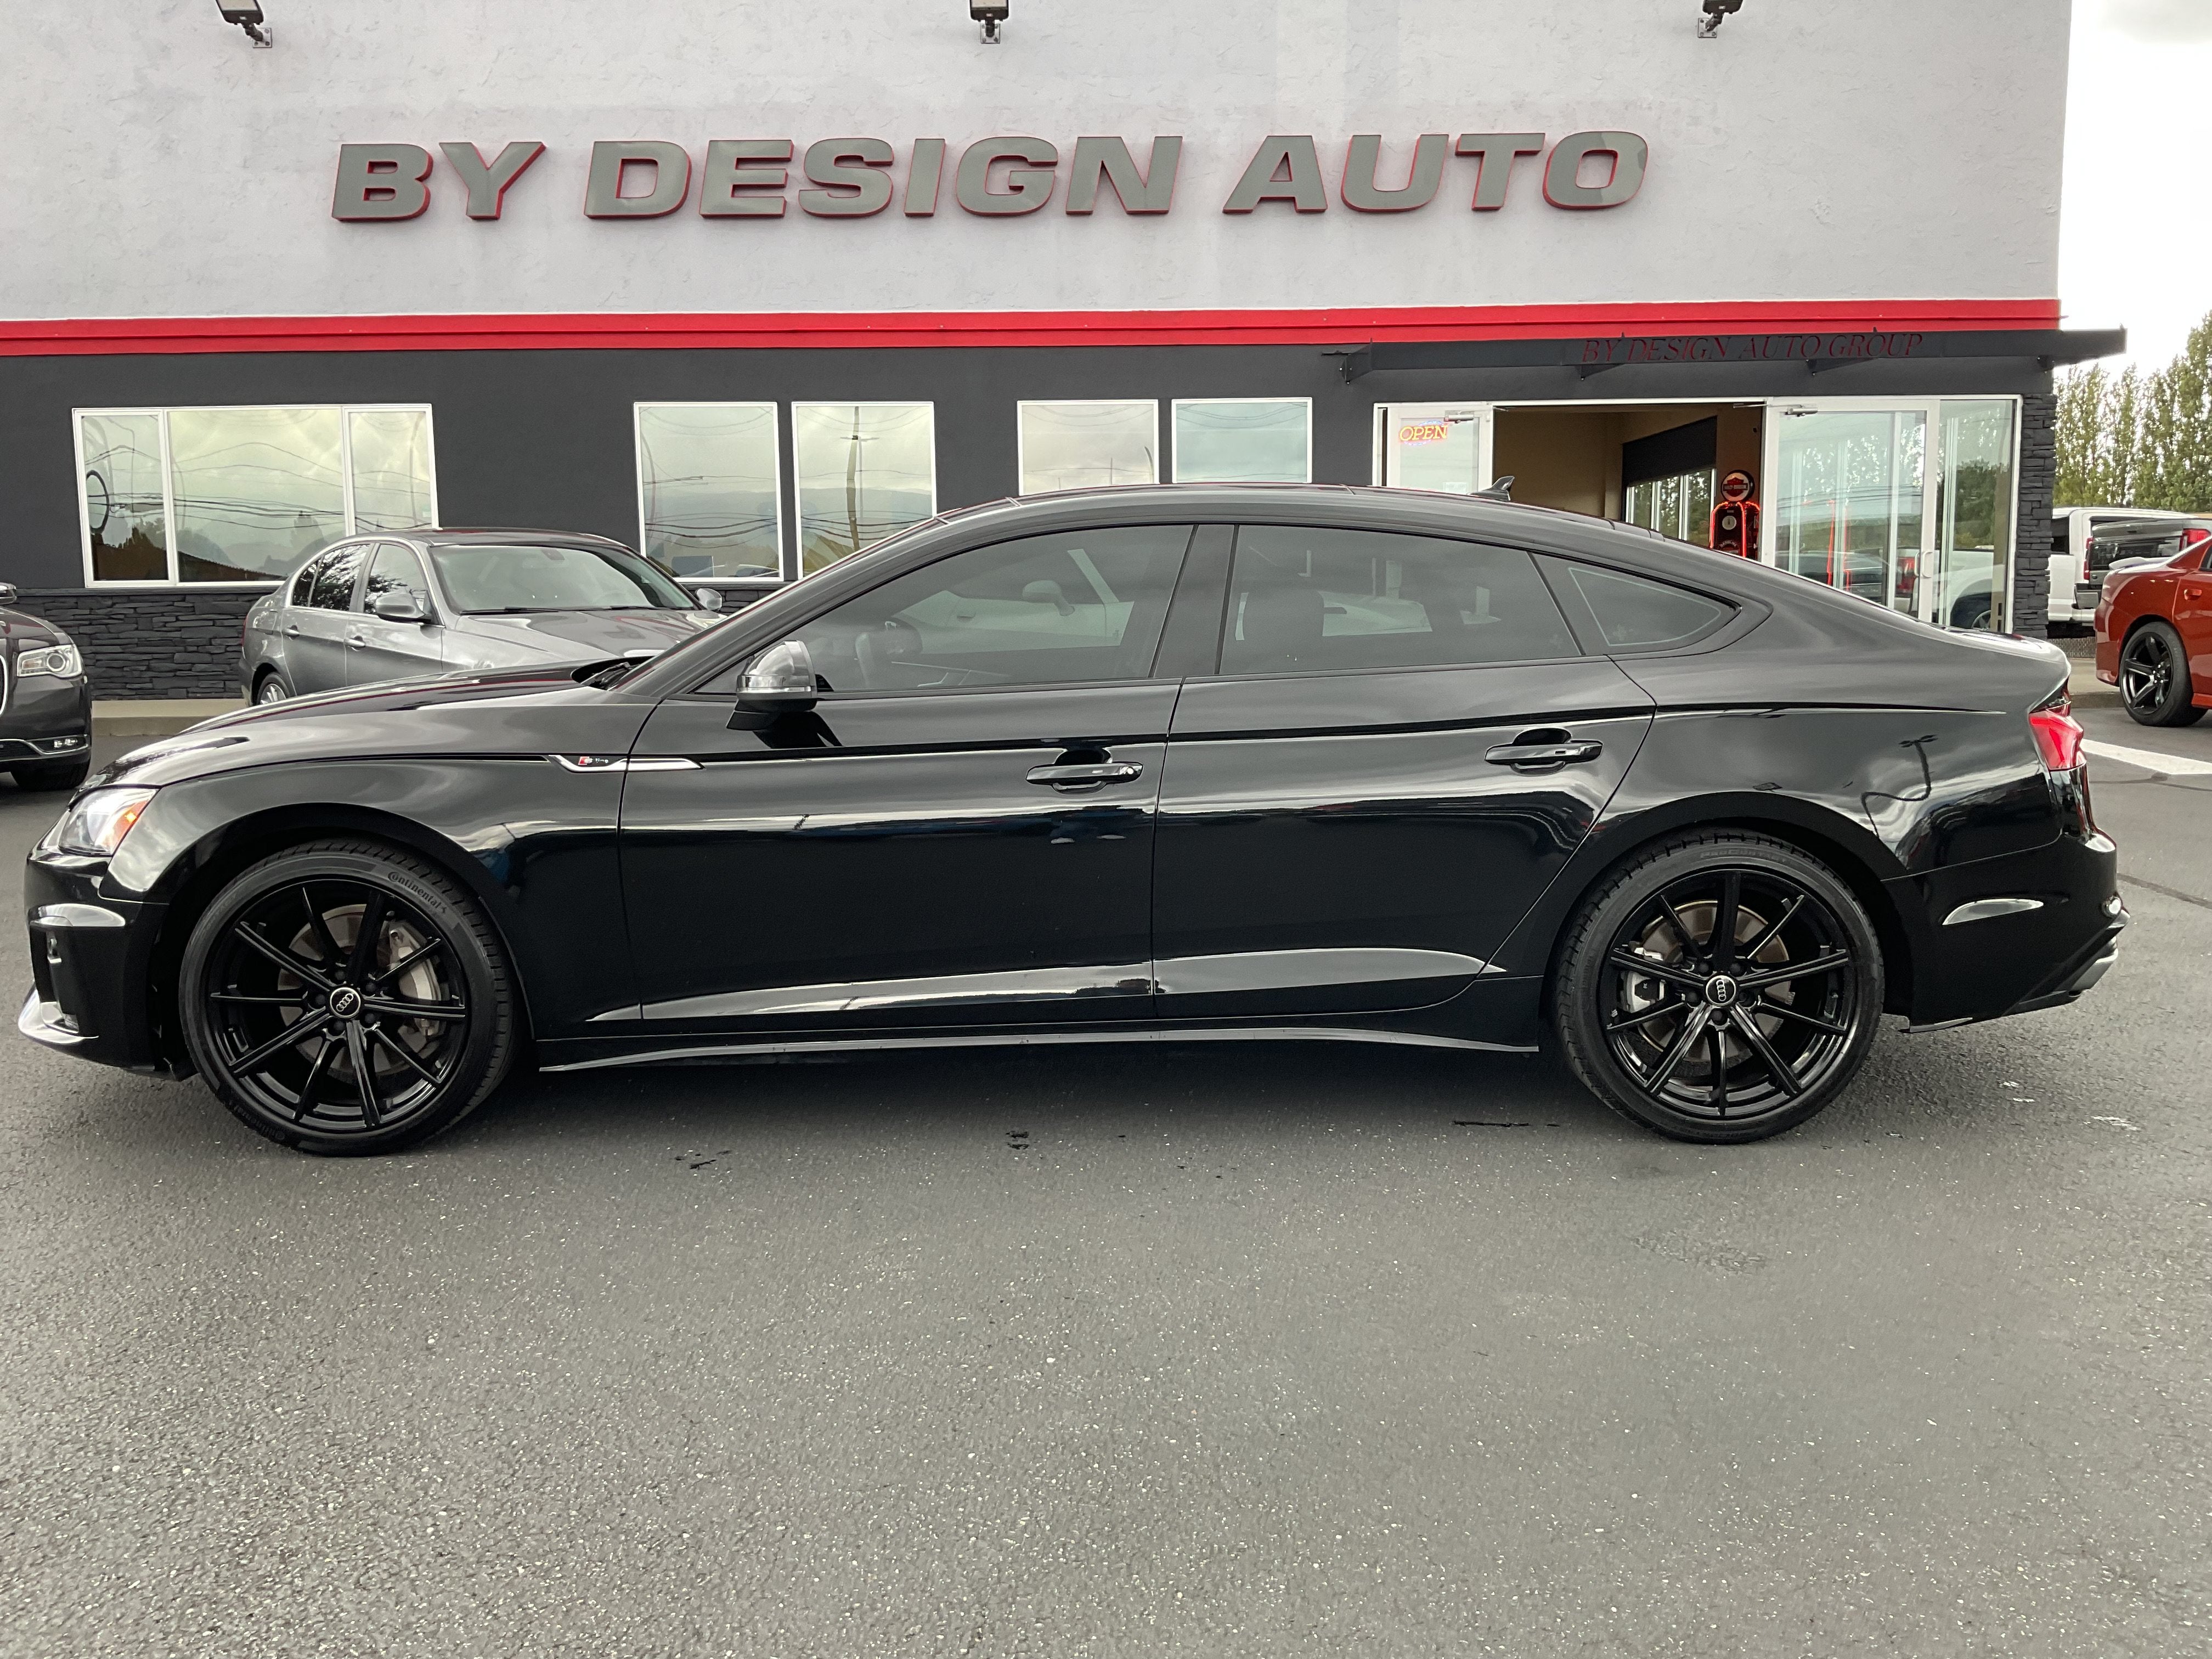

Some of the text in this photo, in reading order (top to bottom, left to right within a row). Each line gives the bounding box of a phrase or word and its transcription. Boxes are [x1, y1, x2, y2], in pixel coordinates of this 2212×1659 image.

[331, 131, 1648, 221] BY DESIGN AUTO
[1582, 332, 1923, 363] BY DESIGN AUTO GROUP
[1400, 425, 1448, 441] OPEN
[387, 871, 442, 909] Continental
